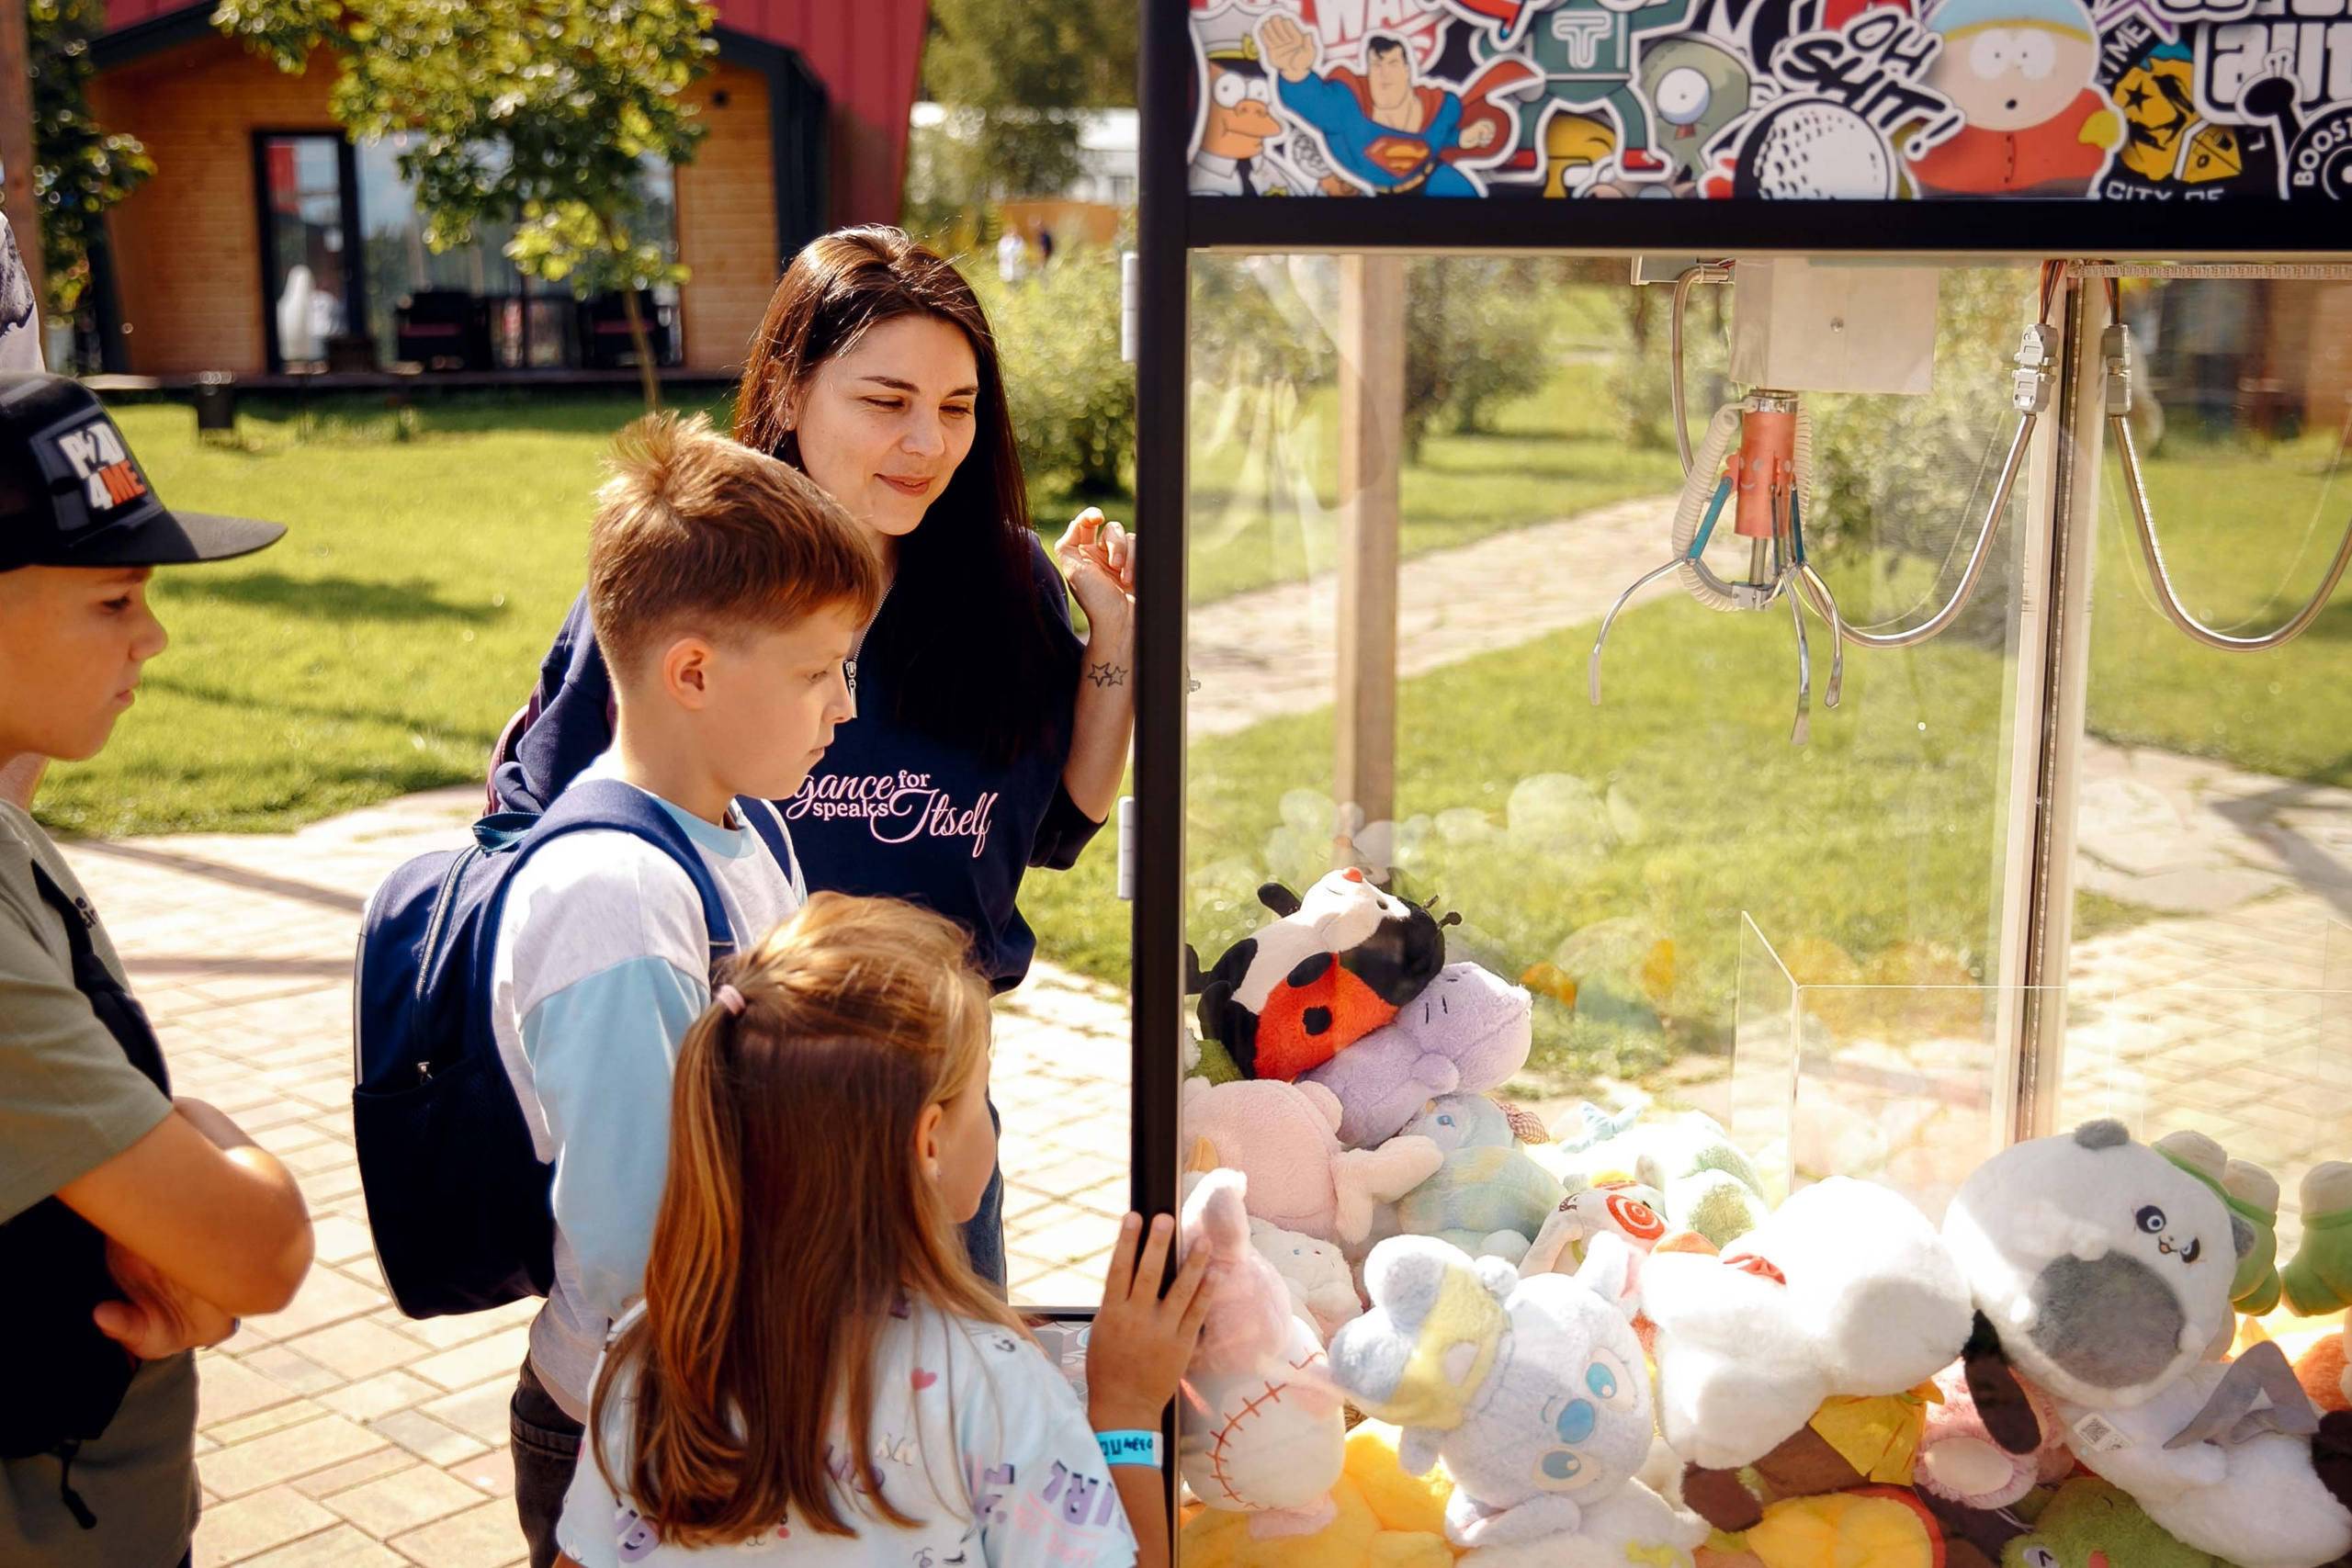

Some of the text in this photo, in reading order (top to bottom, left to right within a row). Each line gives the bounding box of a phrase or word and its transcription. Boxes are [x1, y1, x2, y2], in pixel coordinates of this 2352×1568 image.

[2212, 23, 2352, 104] aut
[786, 770, 999, 858] gance speaks for Itself
[1042, 1459, 1130, 1534] IRL
